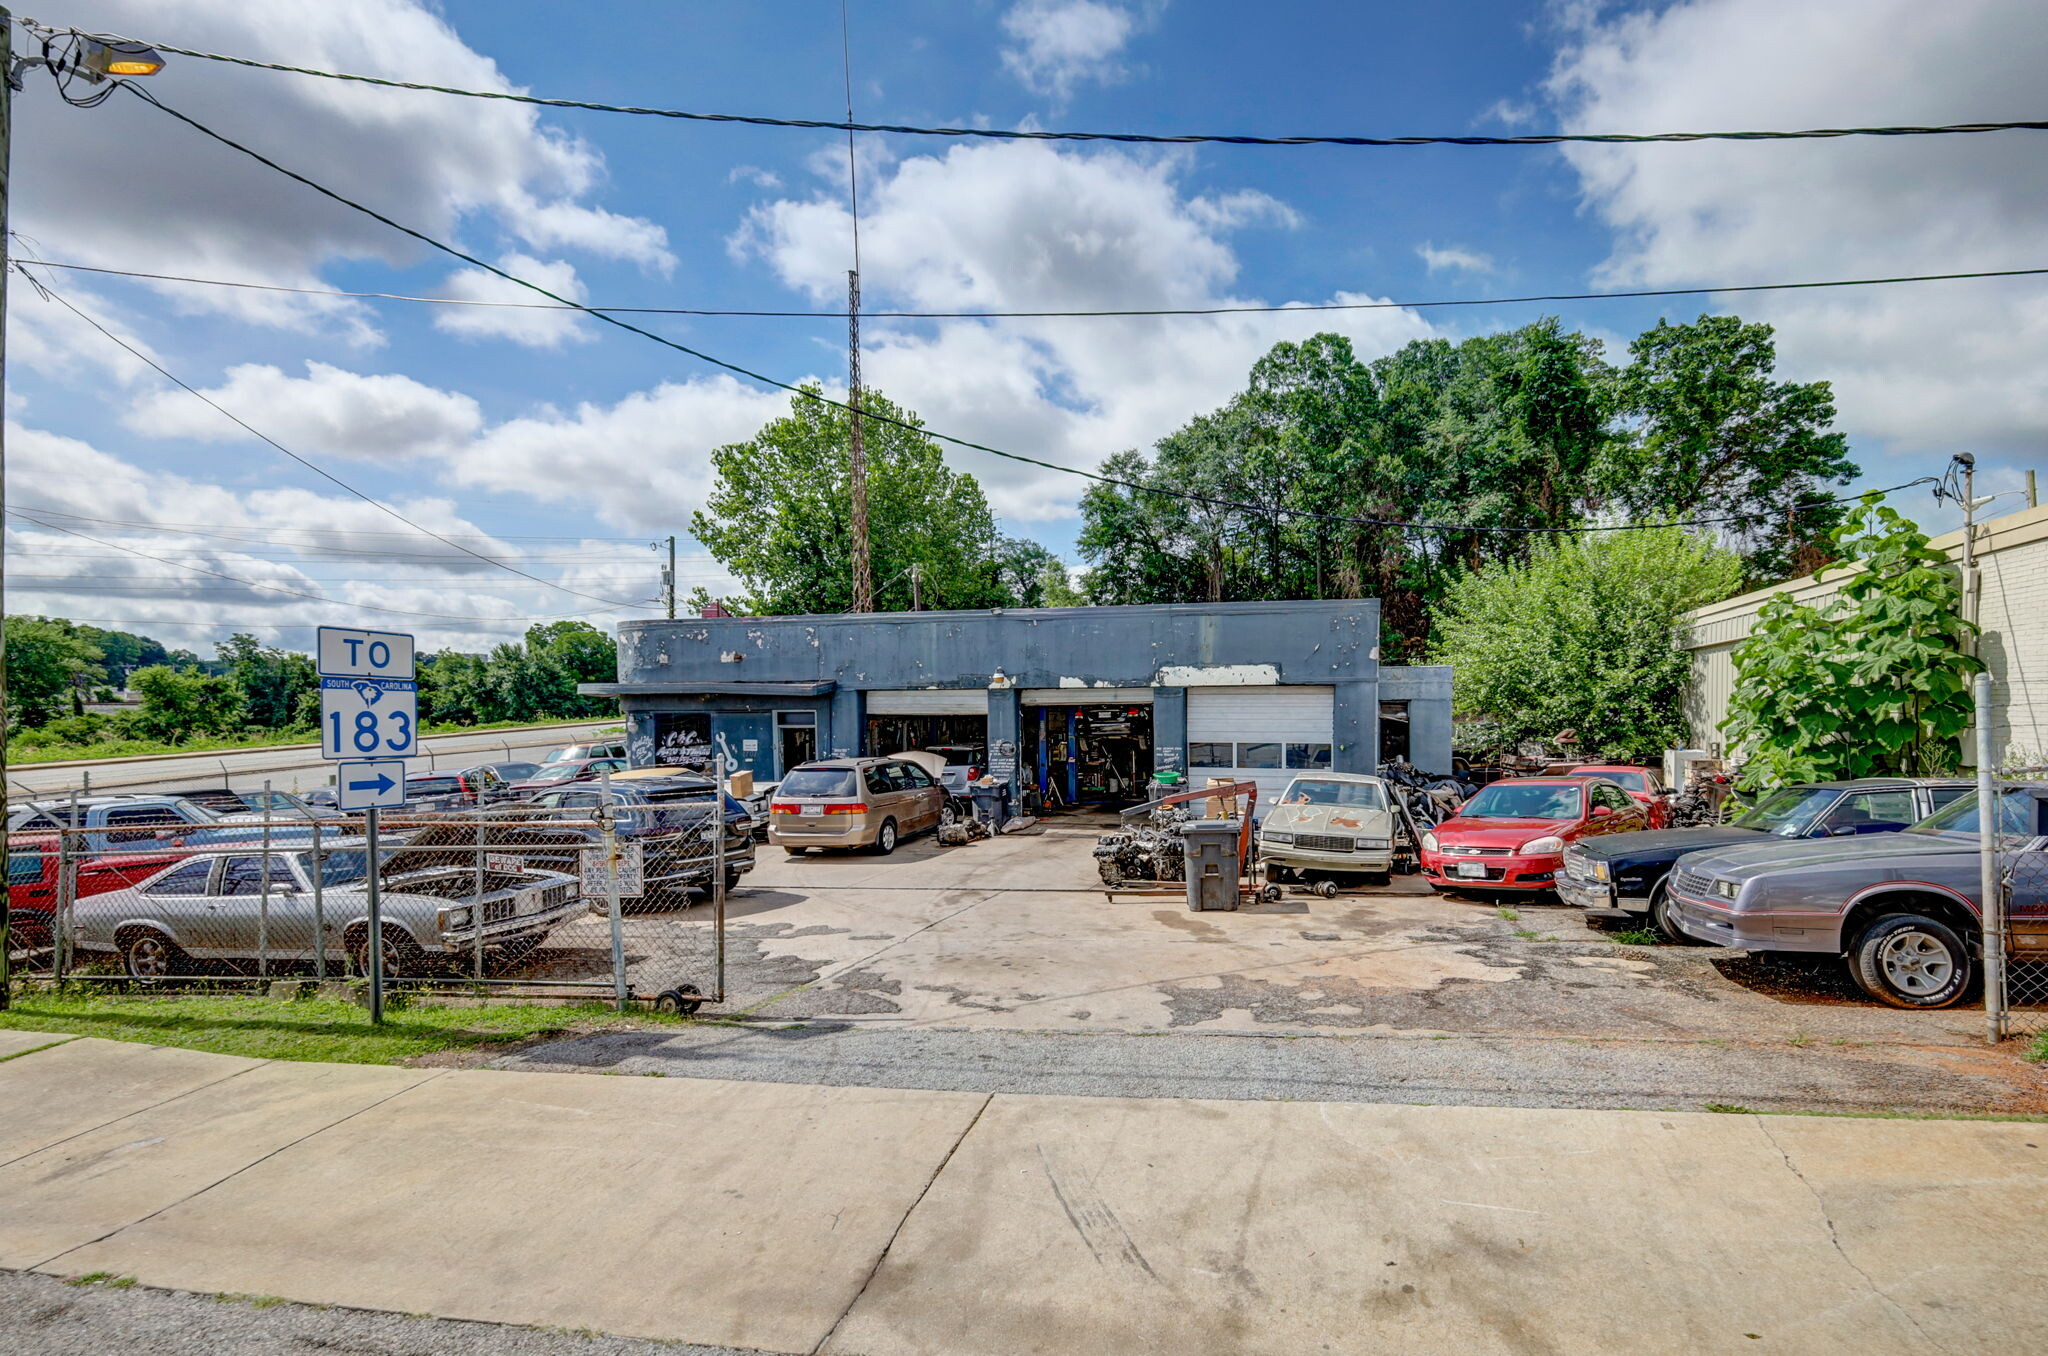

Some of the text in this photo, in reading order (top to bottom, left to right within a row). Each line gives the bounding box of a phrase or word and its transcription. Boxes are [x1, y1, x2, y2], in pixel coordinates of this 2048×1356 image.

[343, 638, 390, 669] TO
[326, 680, 412, 690] SOUTH CAROLINA
[329, 710, 411, 753] 183
[666, 730, 678, 747] C
[687, 730, 698, 745] C
[489, 856, 521, 866] BEWARE
[503, 864, 517, 872] DOG
[1877, 925, 1915, 959] TURBO-TECH
